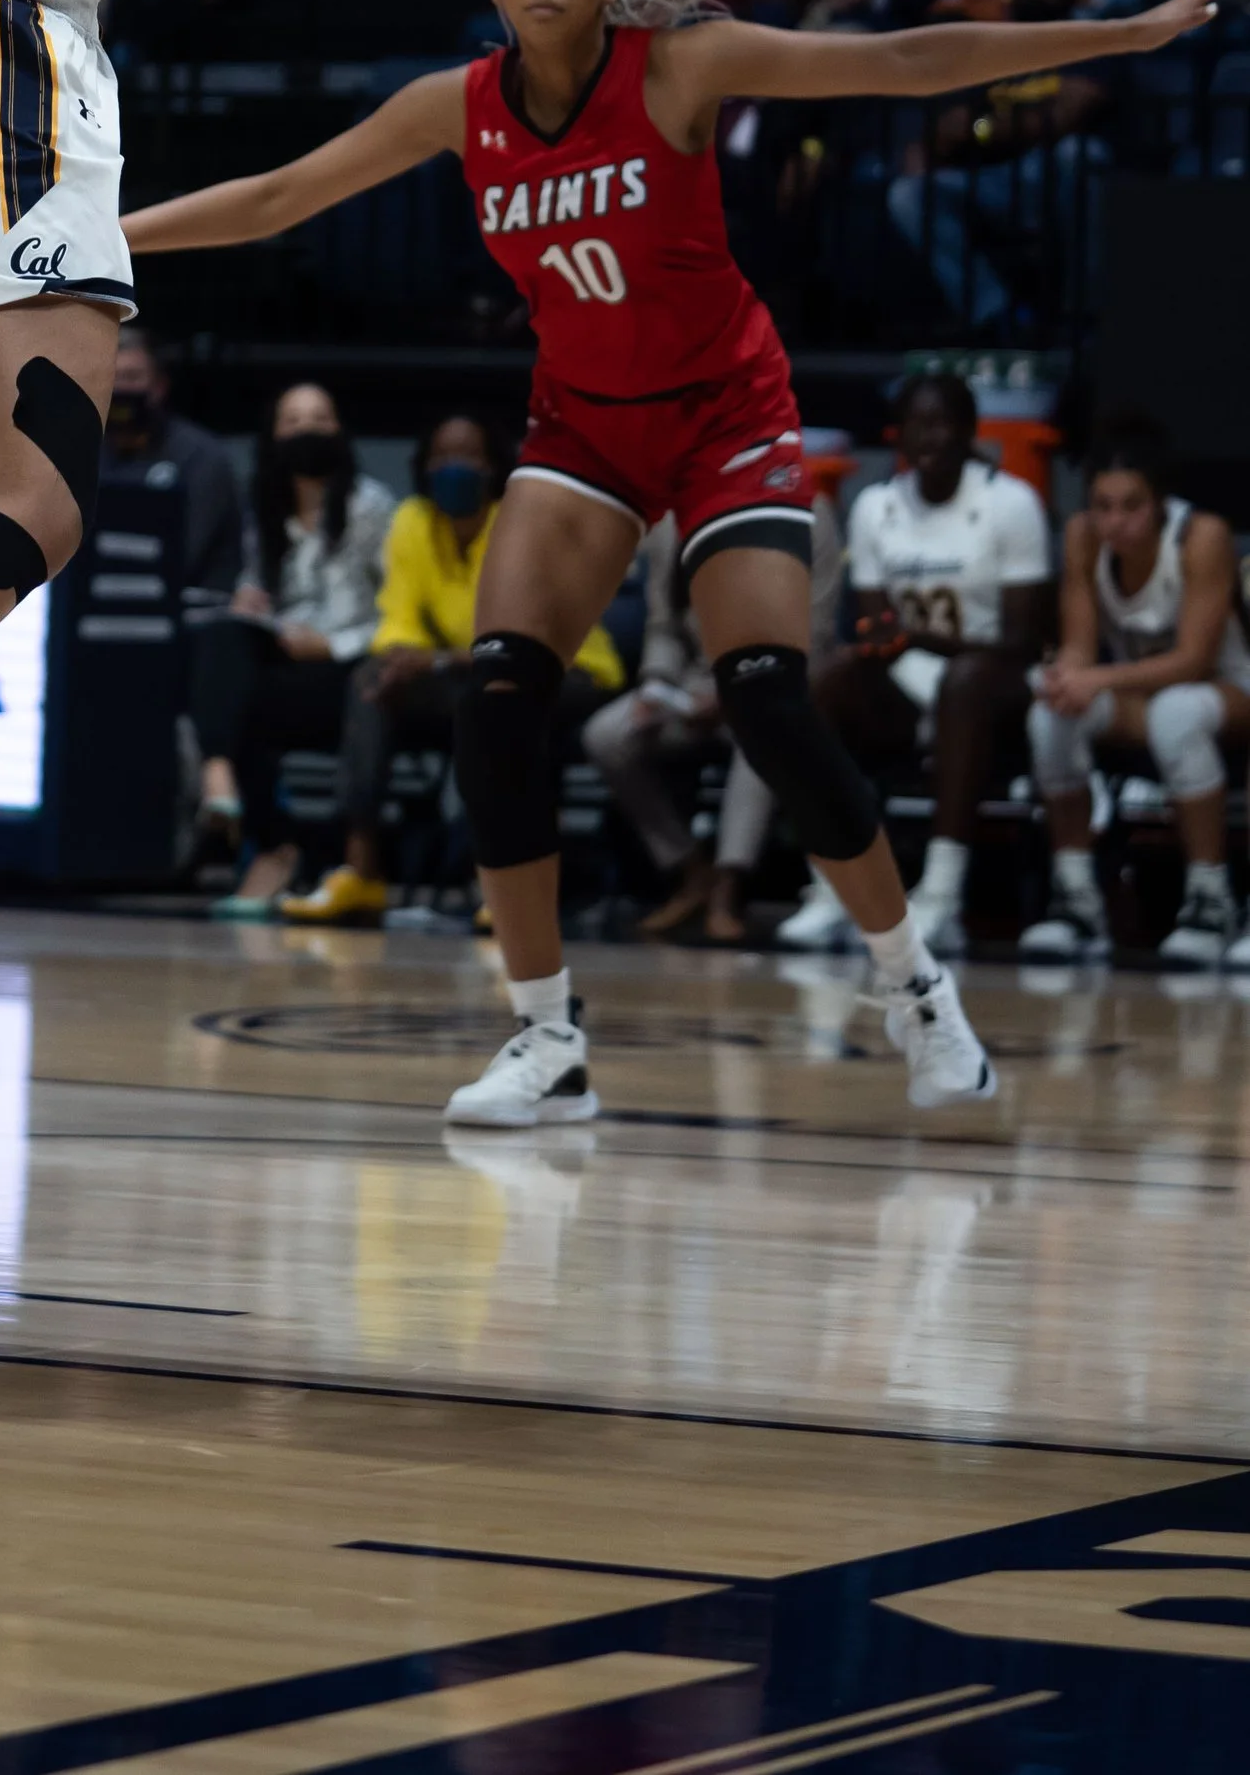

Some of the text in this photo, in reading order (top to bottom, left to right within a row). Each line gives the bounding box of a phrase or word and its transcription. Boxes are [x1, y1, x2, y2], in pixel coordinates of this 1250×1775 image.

[482, 157, 647, 234] SAINTS
[10, 237, 68, 281] Cal
[539, 238, 626, 304] 10
